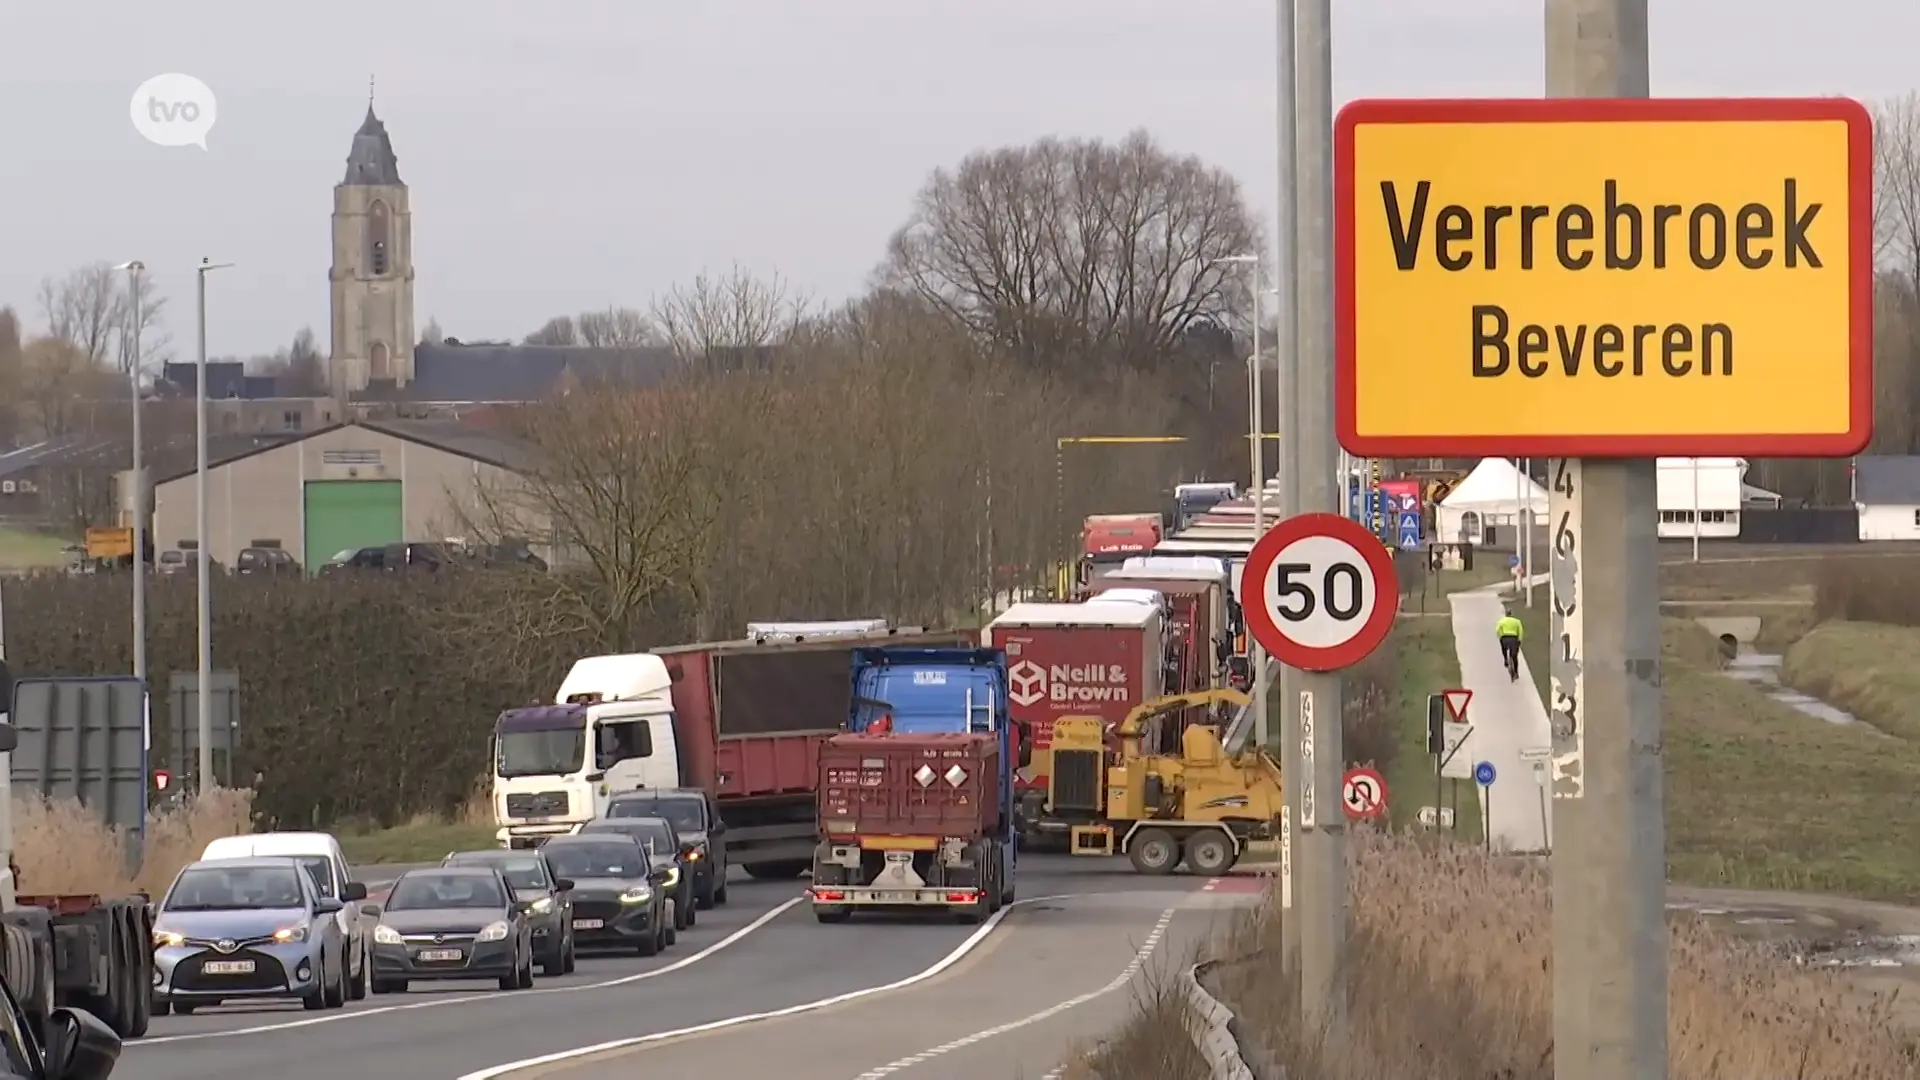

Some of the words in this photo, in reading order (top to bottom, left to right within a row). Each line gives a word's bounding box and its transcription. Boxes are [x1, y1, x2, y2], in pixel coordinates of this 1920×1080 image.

[1380, 178, 1823, 271] Verrebroek
[1472, 305, 1733, 378] Beveren
[1277, 562, 1363, 622] 50
[1050, 664, 1105, 682] Neill
[1108, 664, 1128, 683] &
[1050, 683, 1128, 701] Brown
